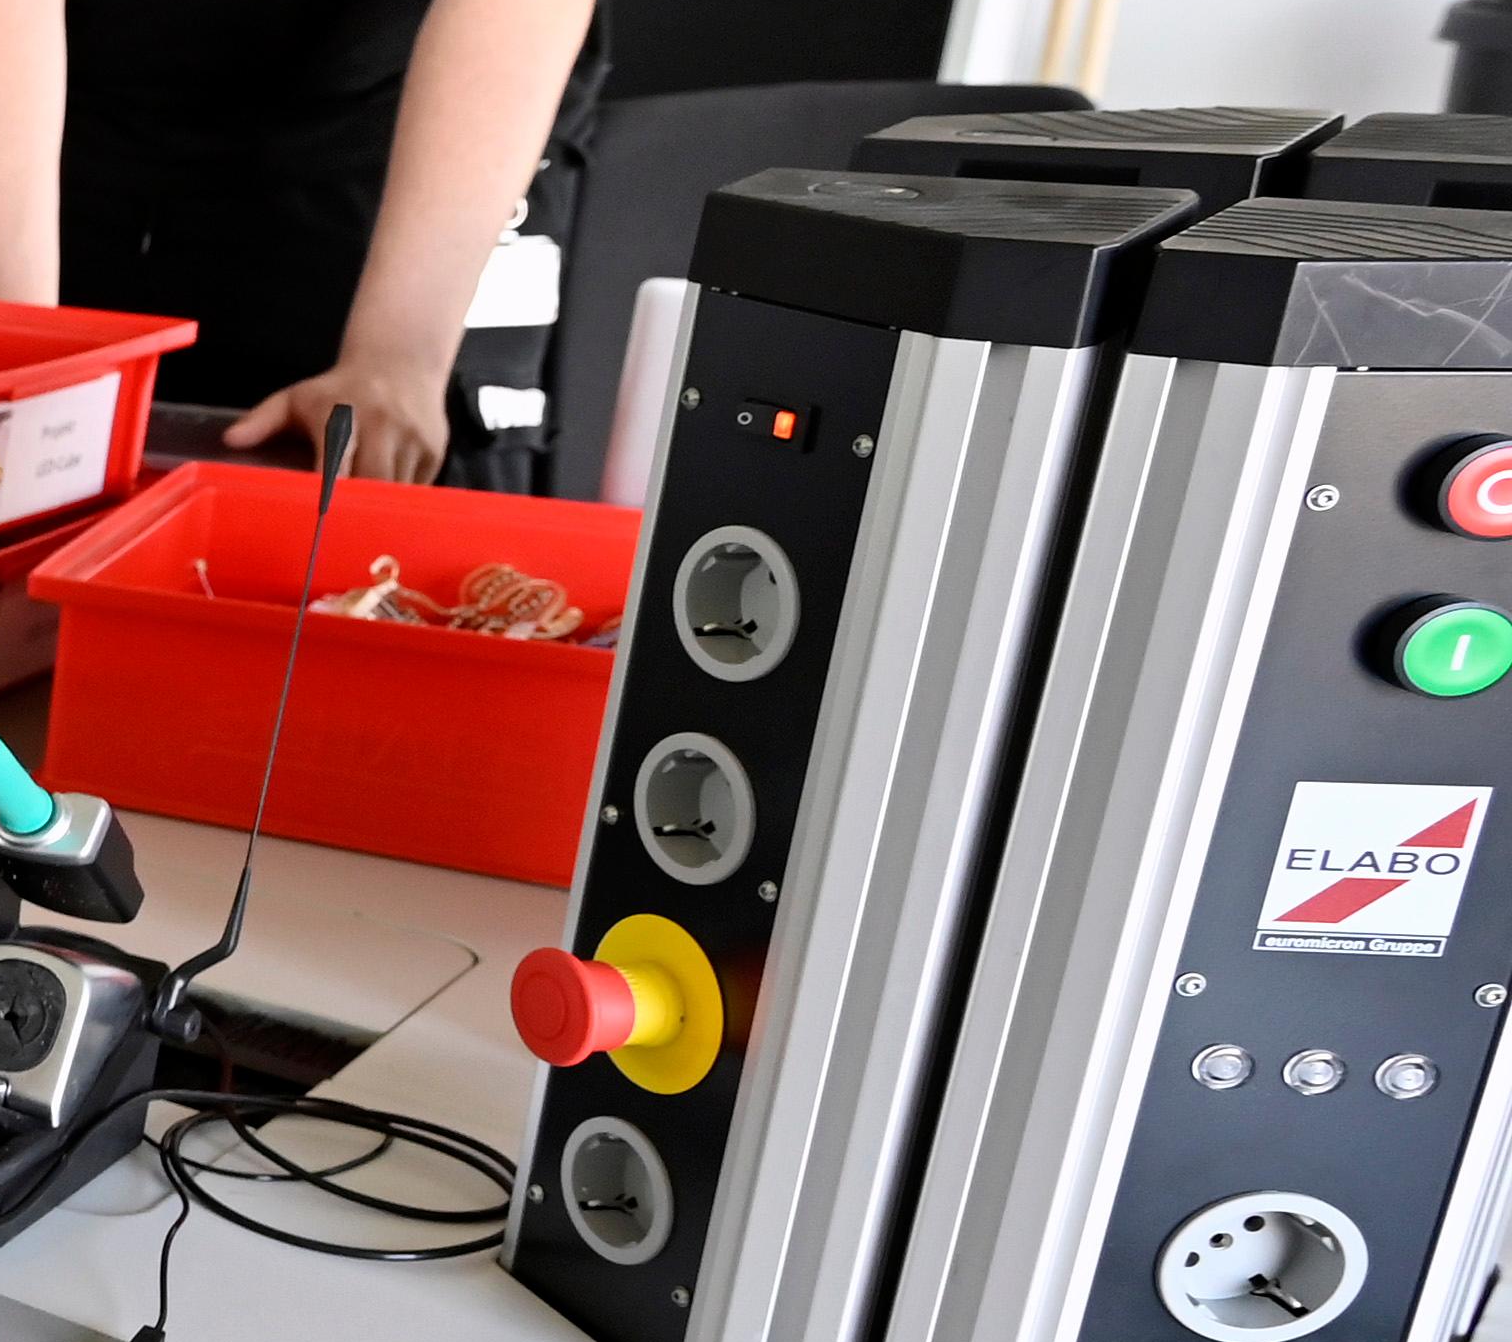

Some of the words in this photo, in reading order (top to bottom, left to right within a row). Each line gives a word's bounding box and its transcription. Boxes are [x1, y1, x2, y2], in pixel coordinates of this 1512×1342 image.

[1285, 848, 1461, 875] ELABO
[1265, 935, 1366, 952] euromicron
[1369, 938, 1436, 954] Gruppe
